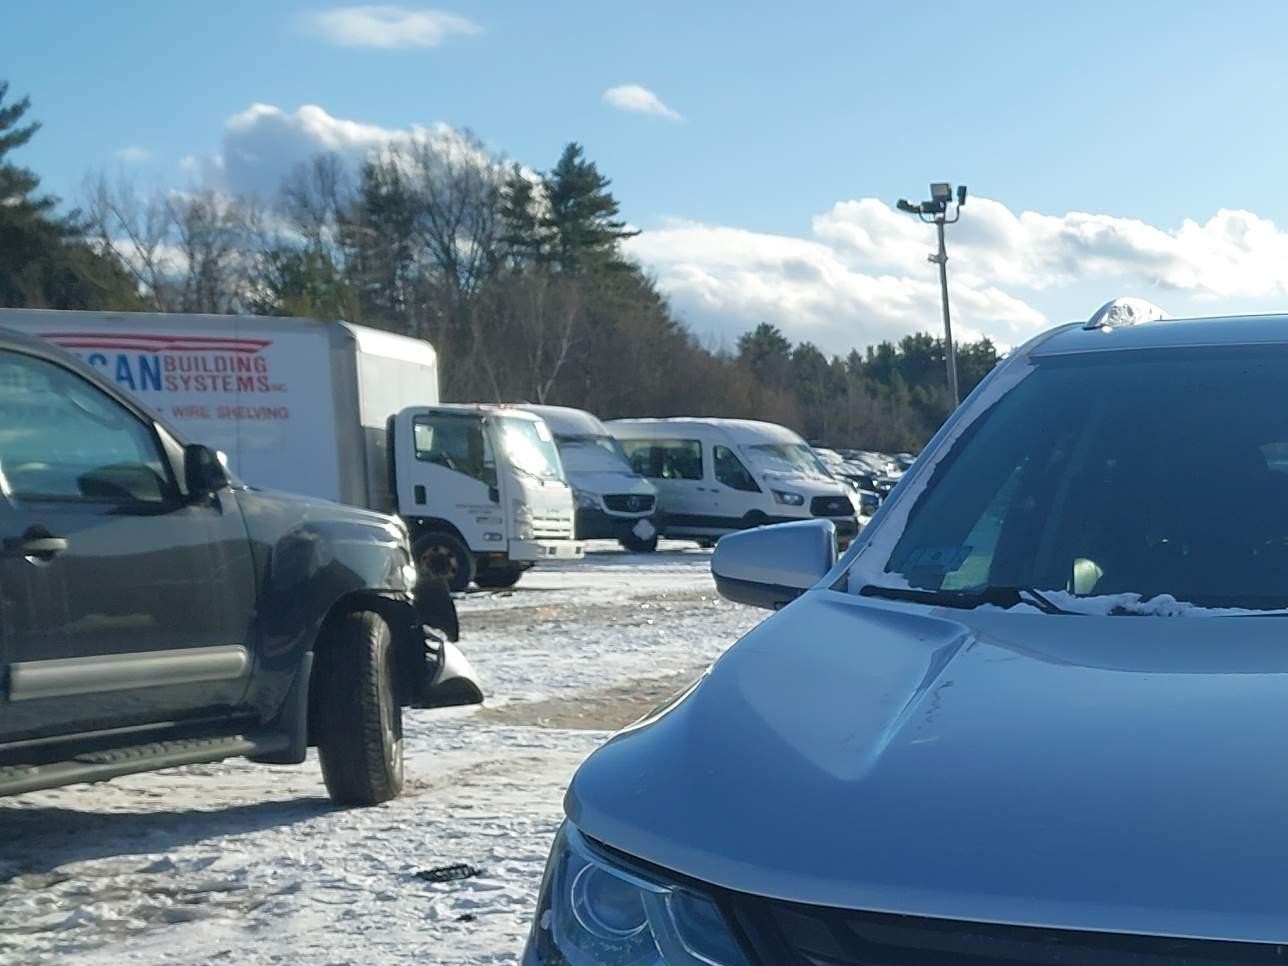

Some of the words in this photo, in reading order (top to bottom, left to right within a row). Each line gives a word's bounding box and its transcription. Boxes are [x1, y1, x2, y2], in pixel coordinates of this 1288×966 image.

[163, 355, 268, 373] BUILDING
[165, 374, 271, 393] SYSTEMS
[172, 405, 209, 419] WIRE
[216, 405, 289, 420] SHELVING
